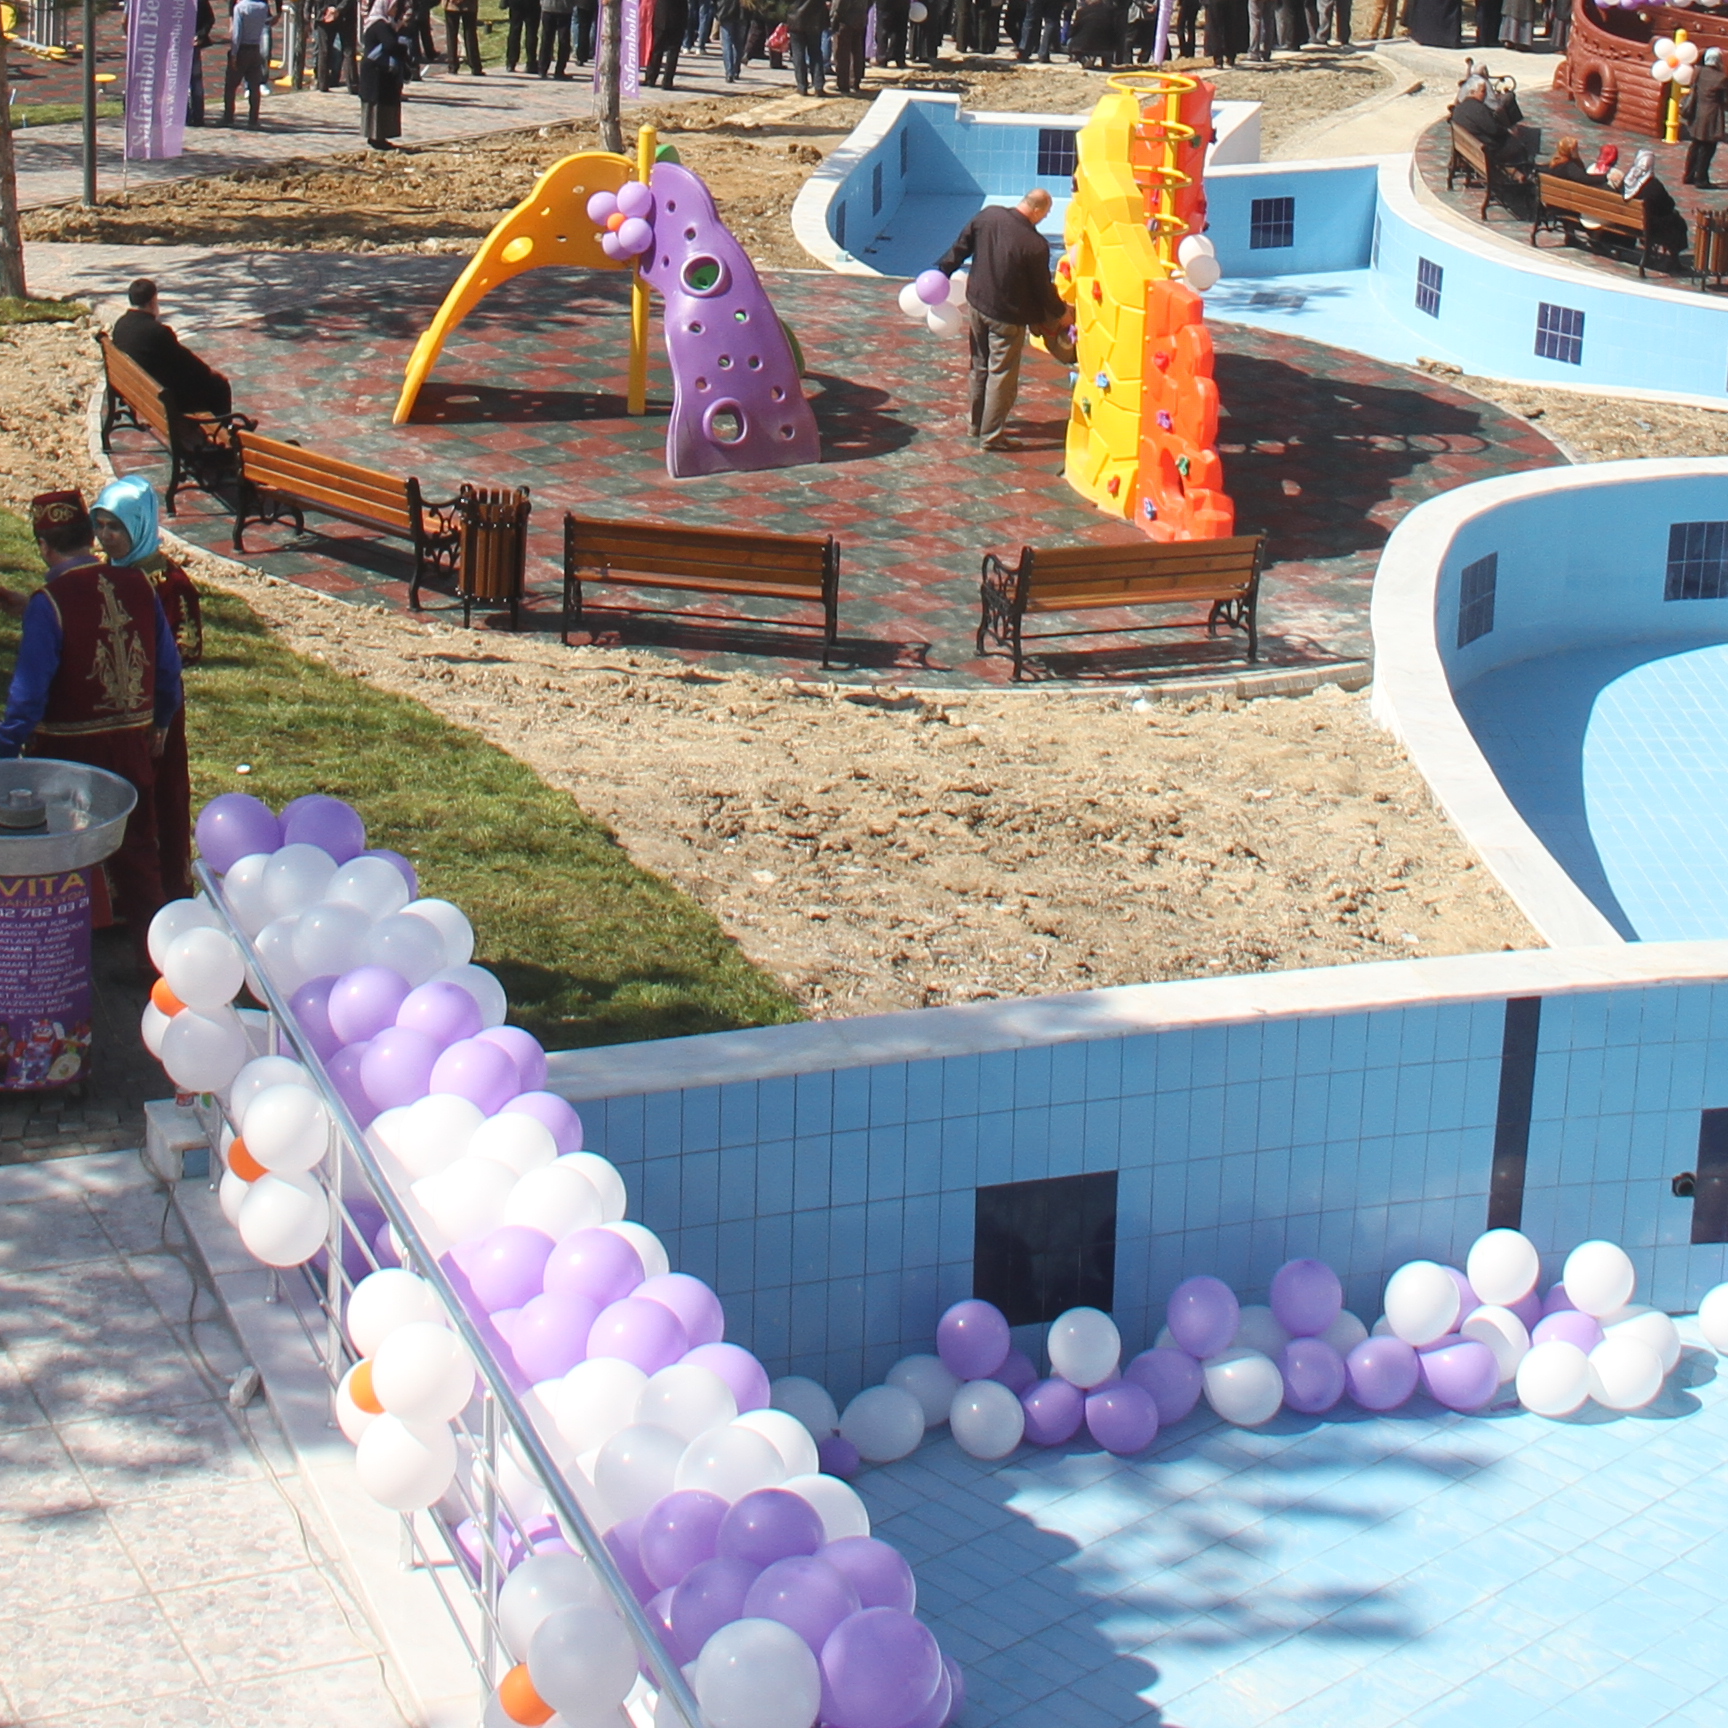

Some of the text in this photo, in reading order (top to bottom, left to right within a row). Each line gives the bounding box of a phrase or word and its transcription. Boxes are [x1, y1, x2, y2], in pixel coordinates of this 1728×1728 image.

[131, 33, 158, 147] Safranbolu
[623, 9, 637, 94] Safranbolu
[21, 906, 53, 919] 782
